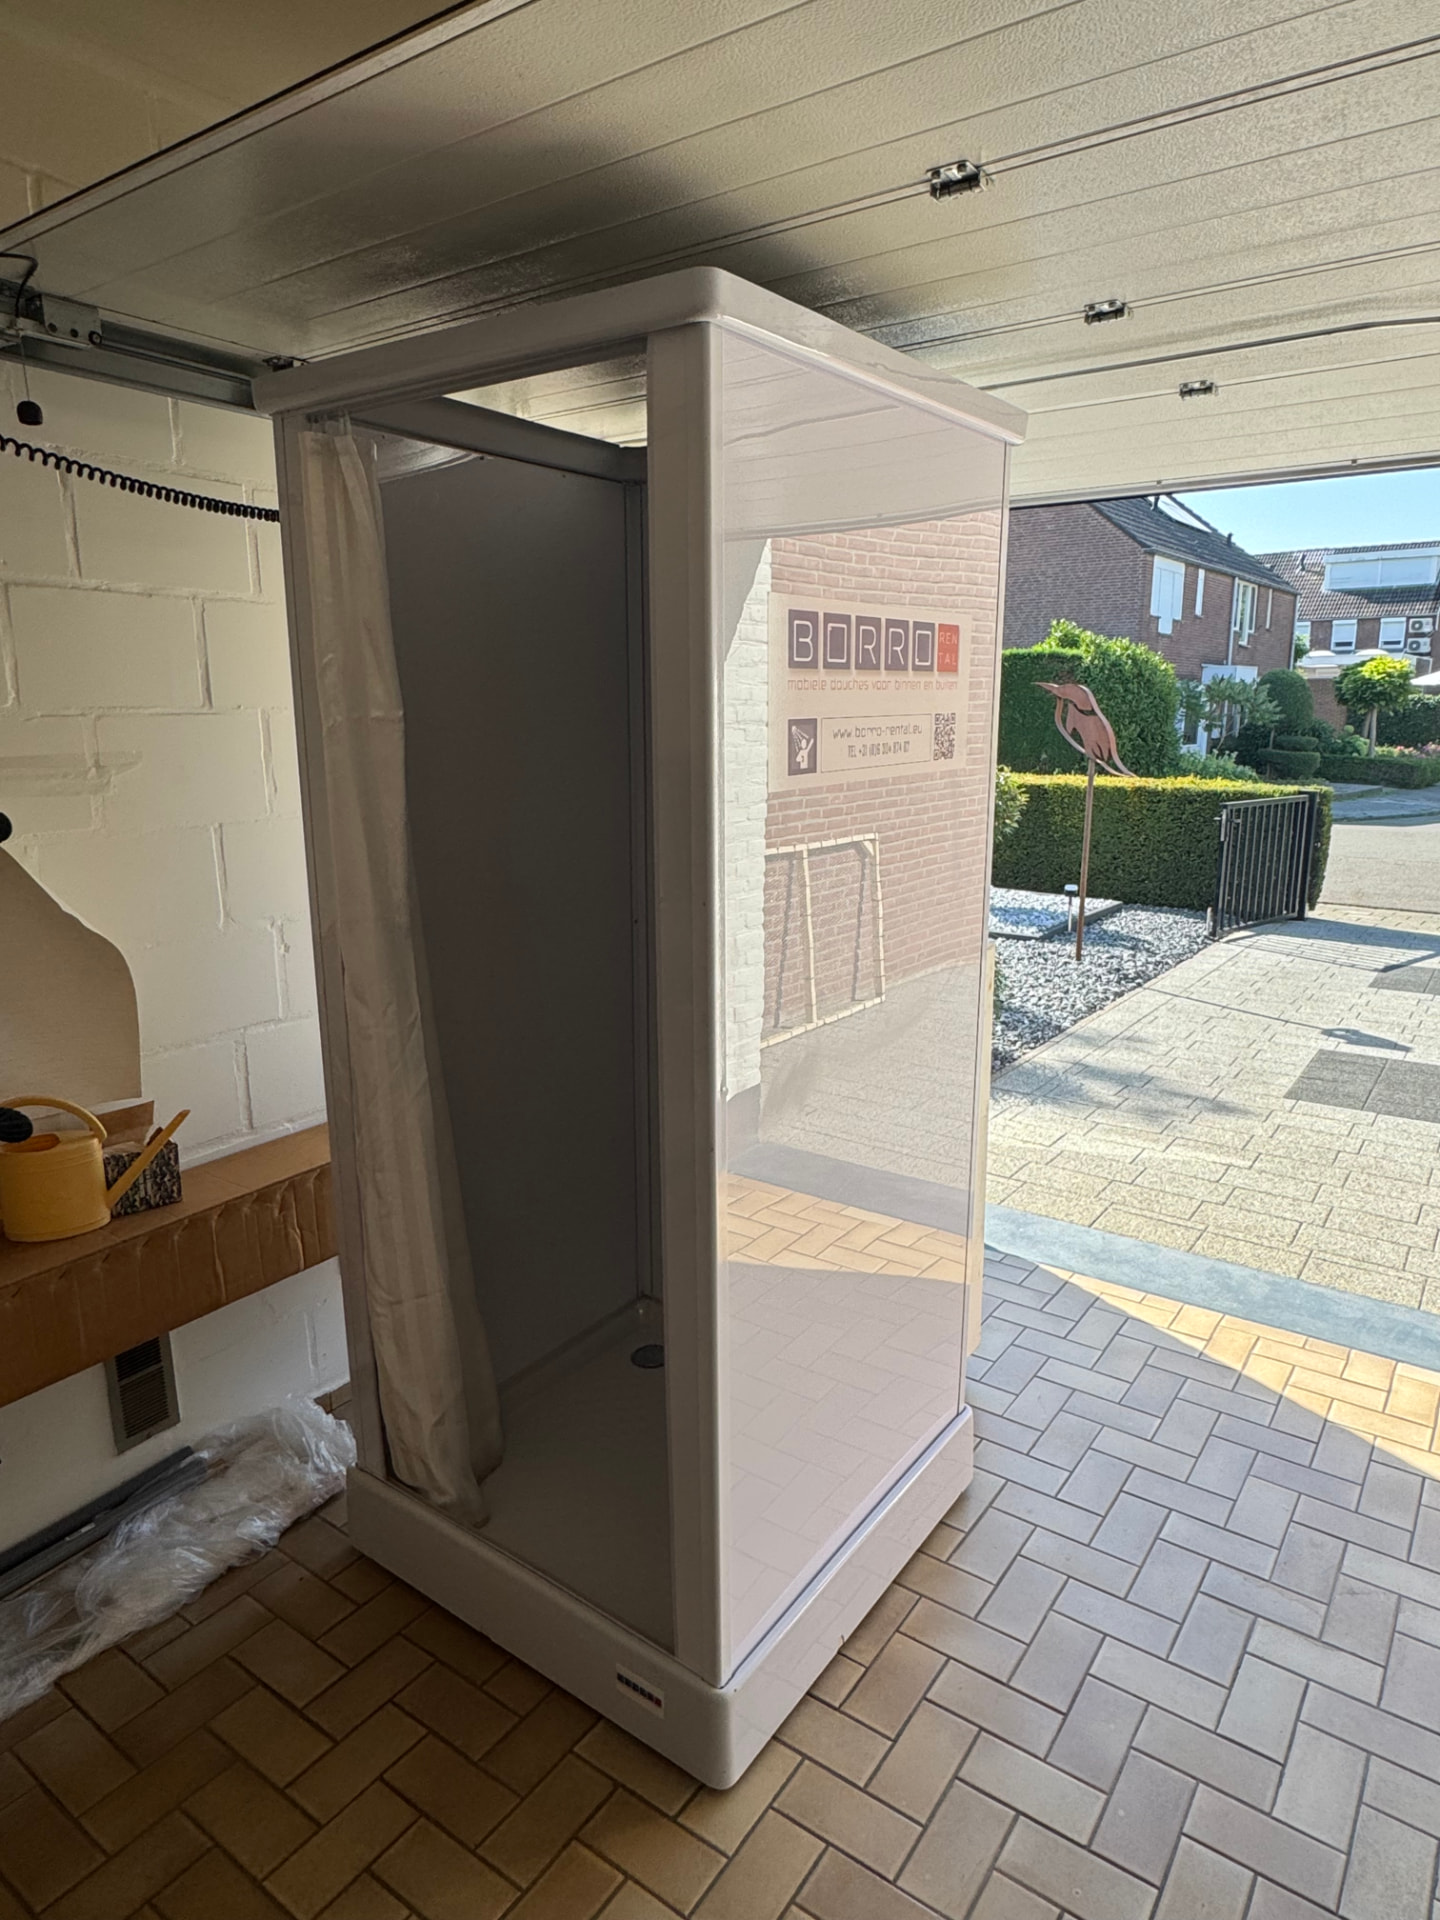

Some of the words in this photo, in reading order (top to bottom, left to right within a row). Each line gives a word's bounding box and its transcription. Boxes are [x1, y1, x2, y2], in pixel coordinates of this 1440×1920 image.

[792, 618, 932, 667] BORRO
[939, 631, 958, 645] REN
[938, 652, 957, 666] TAL
[787, 678, 827, 691] mobiele
[830, 678, 869, 691] douches
[871, 680, 892, 690] voor
[894, 678, 921, 690] binnen
[924, 680, 933, 690] en
[832, 722, 923, 740] www.borro-rental.eu
